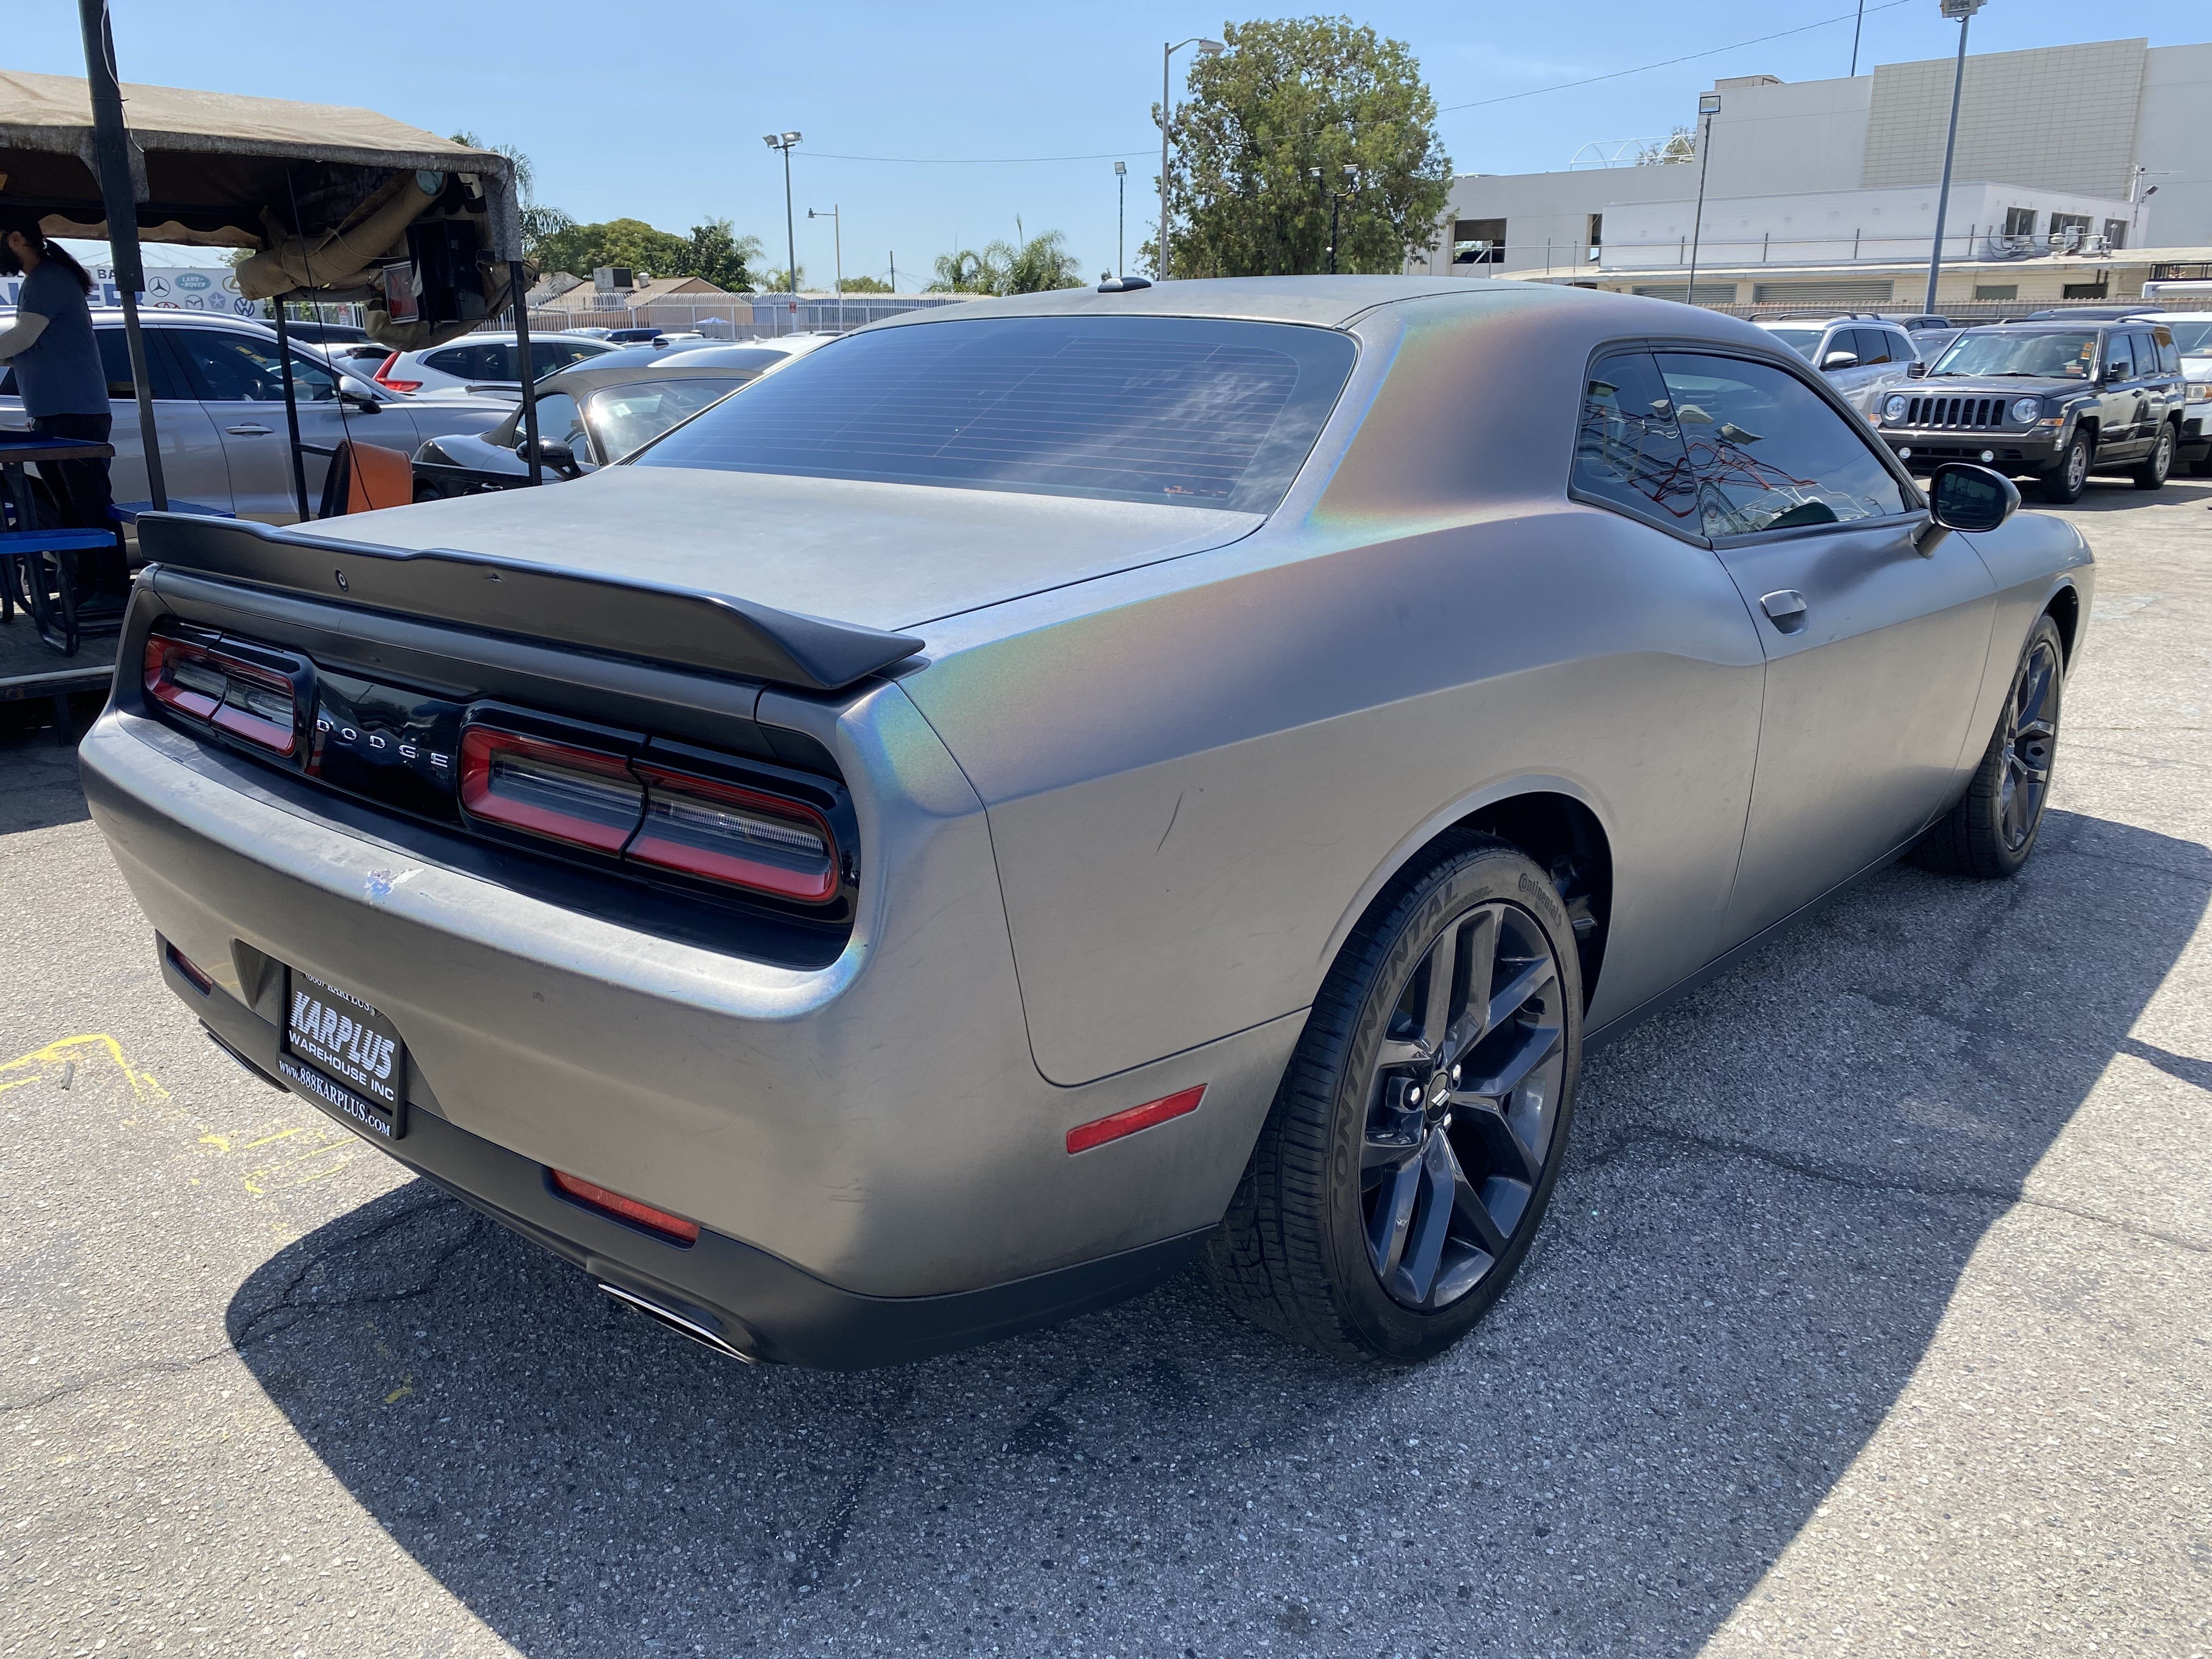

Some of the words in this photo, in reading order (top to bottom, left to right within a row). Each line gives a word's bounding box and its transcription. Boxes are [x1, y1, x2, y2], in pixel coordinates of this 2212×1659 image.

[317, 719, 449, 768] DODGE
[1518, 872, 1559, 922] Continental
[289, 990, 395, 1080] KARPLUS
[289, 1030, 367, 1086] WAREHOUSE
[371, 1078, 394, 1102] INC
[1333, 881, 1458, 1212] CONTINENTAL
